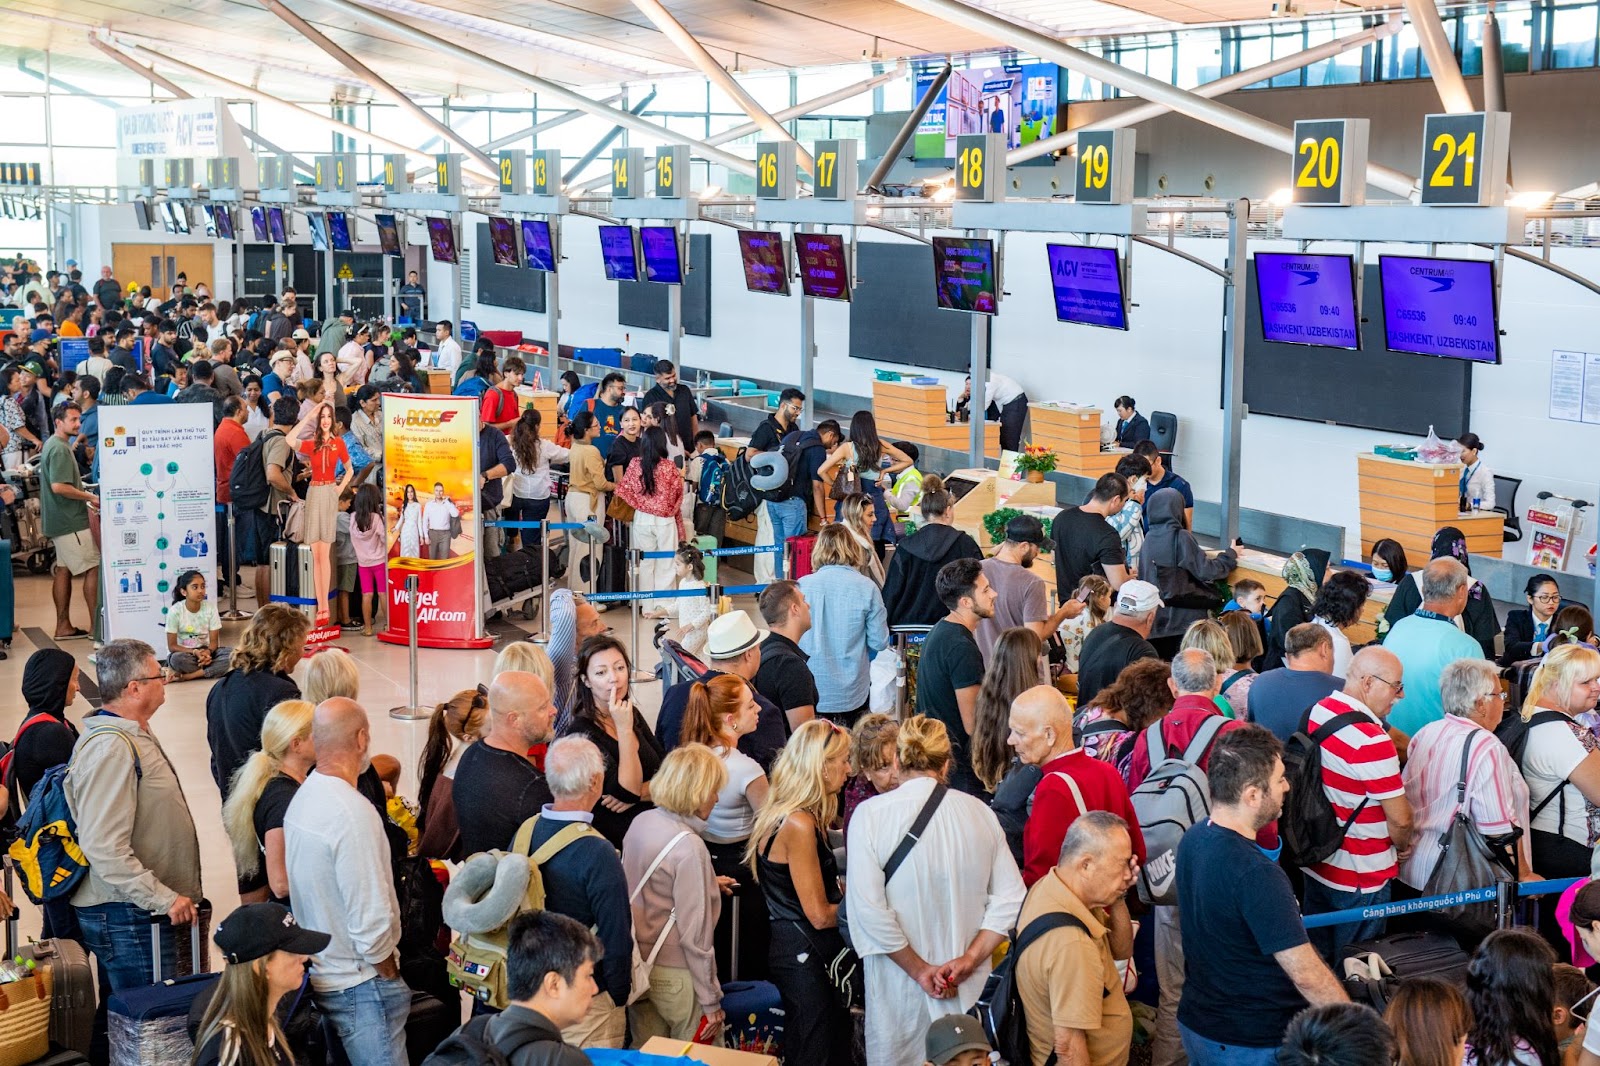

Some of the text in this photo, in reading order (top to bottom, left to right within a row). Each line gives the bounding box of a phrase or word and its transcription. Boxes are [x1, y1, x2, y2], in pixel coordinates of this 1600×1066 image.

[500, 158, 512, 185] 12
[658, 156, 672, 187] 15
[759, 154, 777, 188] 16
[818, 152, 836, 187] 17
[959, 148, 983, 188] 18
[1081, 145, 1109, 188] 19
[1297, 137, 1340, 188] 20
[1429, 132, 1476, 187] 21
[179, 163, 185, 182] 3
[208, 162, 214, 183] 4
[223, 163, 229, 184] 5
[259, 162, 265, 183] 6
[316, 162, 321, 186] 8
[337, 161, 344, 186] 9
[385, 162, 394, 186] 10
[438, 163, 448, 186] 11
[534, 158, 546, 187] 13
[614, 158, 628, 188] 14
[1057, 260, 1078, 277] ACV
[1281, 262, 1320, 271] CENTRUMAIR
[1410, 266, 1454, 276] CENTRUMAIR
[1320, 305, 1340, 316] 09:40
[1396, 309, 1477, 327] C65536 09:40
[1265, 322, 1355, 340] TASHKENT, UZBEKISTAN
[1388, 331, 1494, 353] TASHKENT, UZBEKISTAN
[416, 608, 466, 624] Air.com
[1147, 849, 1176, 883] NIKE
[1363, 908, 1384, 918] Cảng
[1386, 903, 1406, 914] hàng
[1407, 900, 1434, 911] không
[1434, 894, 1455, 907] quốc
[1455, 892, 1464, 903] tế
[1485, 889, 1497, 898] Qu
